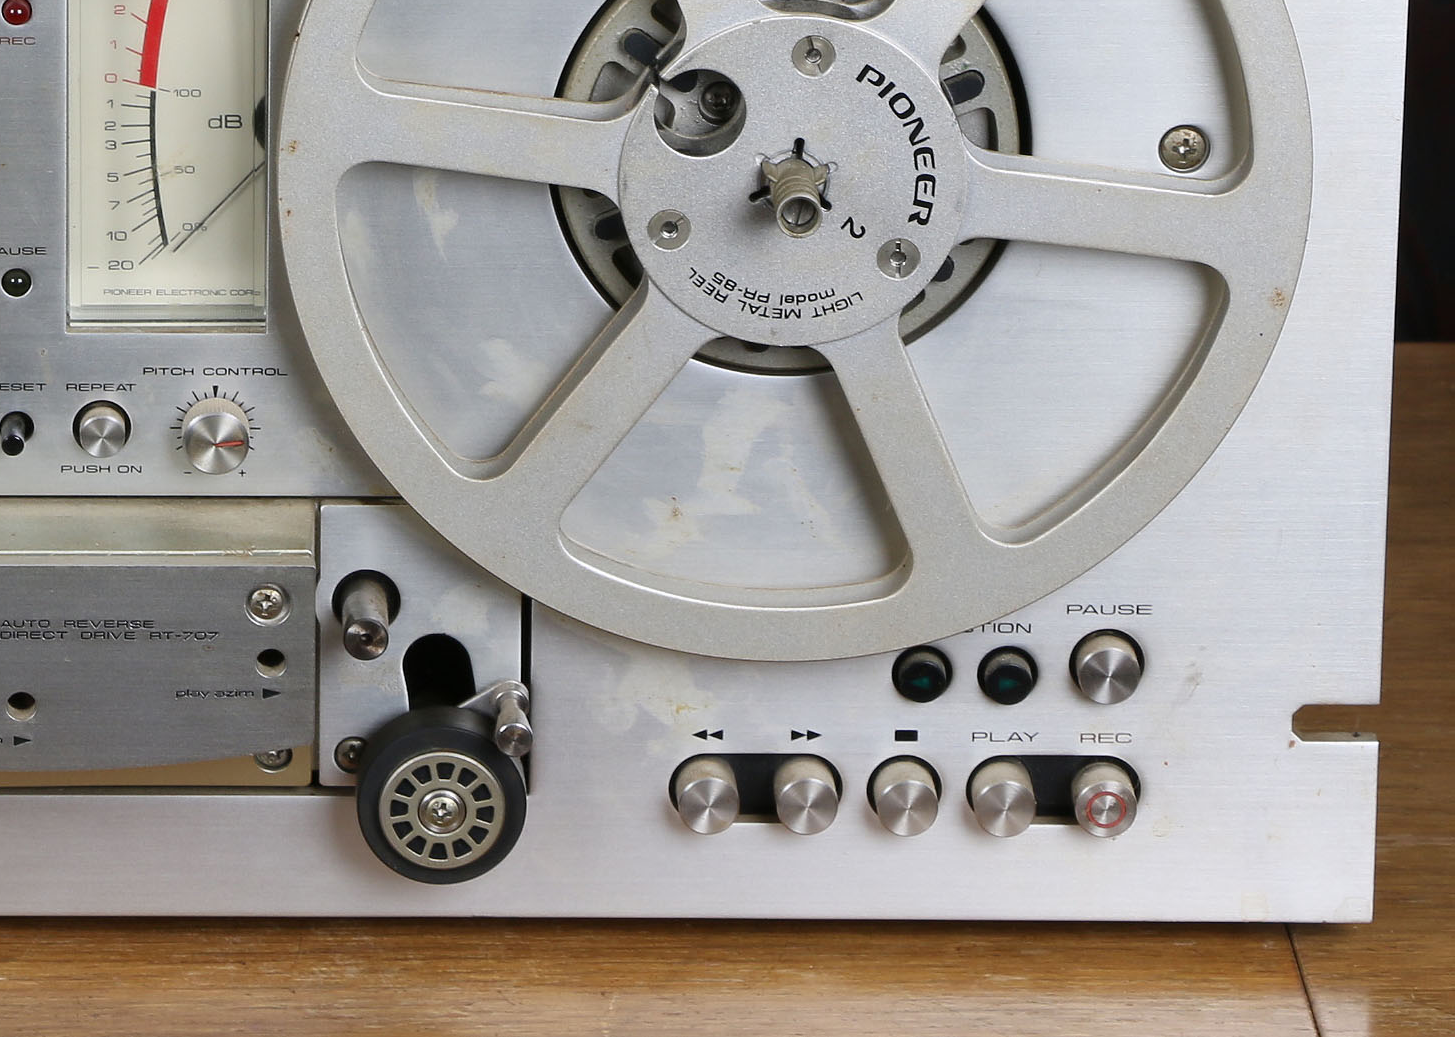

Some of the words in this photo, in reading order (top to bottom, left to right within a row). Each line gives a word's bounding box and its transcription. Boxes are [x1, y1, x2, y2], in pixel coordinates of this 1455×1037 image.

[173, 88, 202, 98] 100
[208, 114, 243, 130] dB
[855, 63, 937, 226] PIONEER
[174, 165, 196, 175] 50
[840, 215, 867, 240] 2
[688, 265, 729, 304] REEL
[711, 270, 771, 303] PR-85
[103, 287, 152, 296] PIONEER
[155, 287, 228, 297] ELECTRONIC
[779, 288, 837, 306] model
[740, 300, 802, 320] METAL
[811, 290, 864, 319] LIGHT
[142, 366, 195, 376] PITCH
[202, 366, 289, 377] CONTROL
[65, 382, 137, 394] REPEAT
[60, 464, 111, 474] PUSH
[117, 464, 143, 474] ON
[1066, 604, 1153, 616] PAUSE
[0, 619, 51, 630] AUTO
[63, 619, 155, 630] REVERSE
[0, 630, 69, 642] DIRECT
[80, 630, 136, 642] DRIVE
[149, 631, 220, 642] RT-707
[971, 731, 1039, 743] PLAY
[1079, 732, 1132, 744] REC
